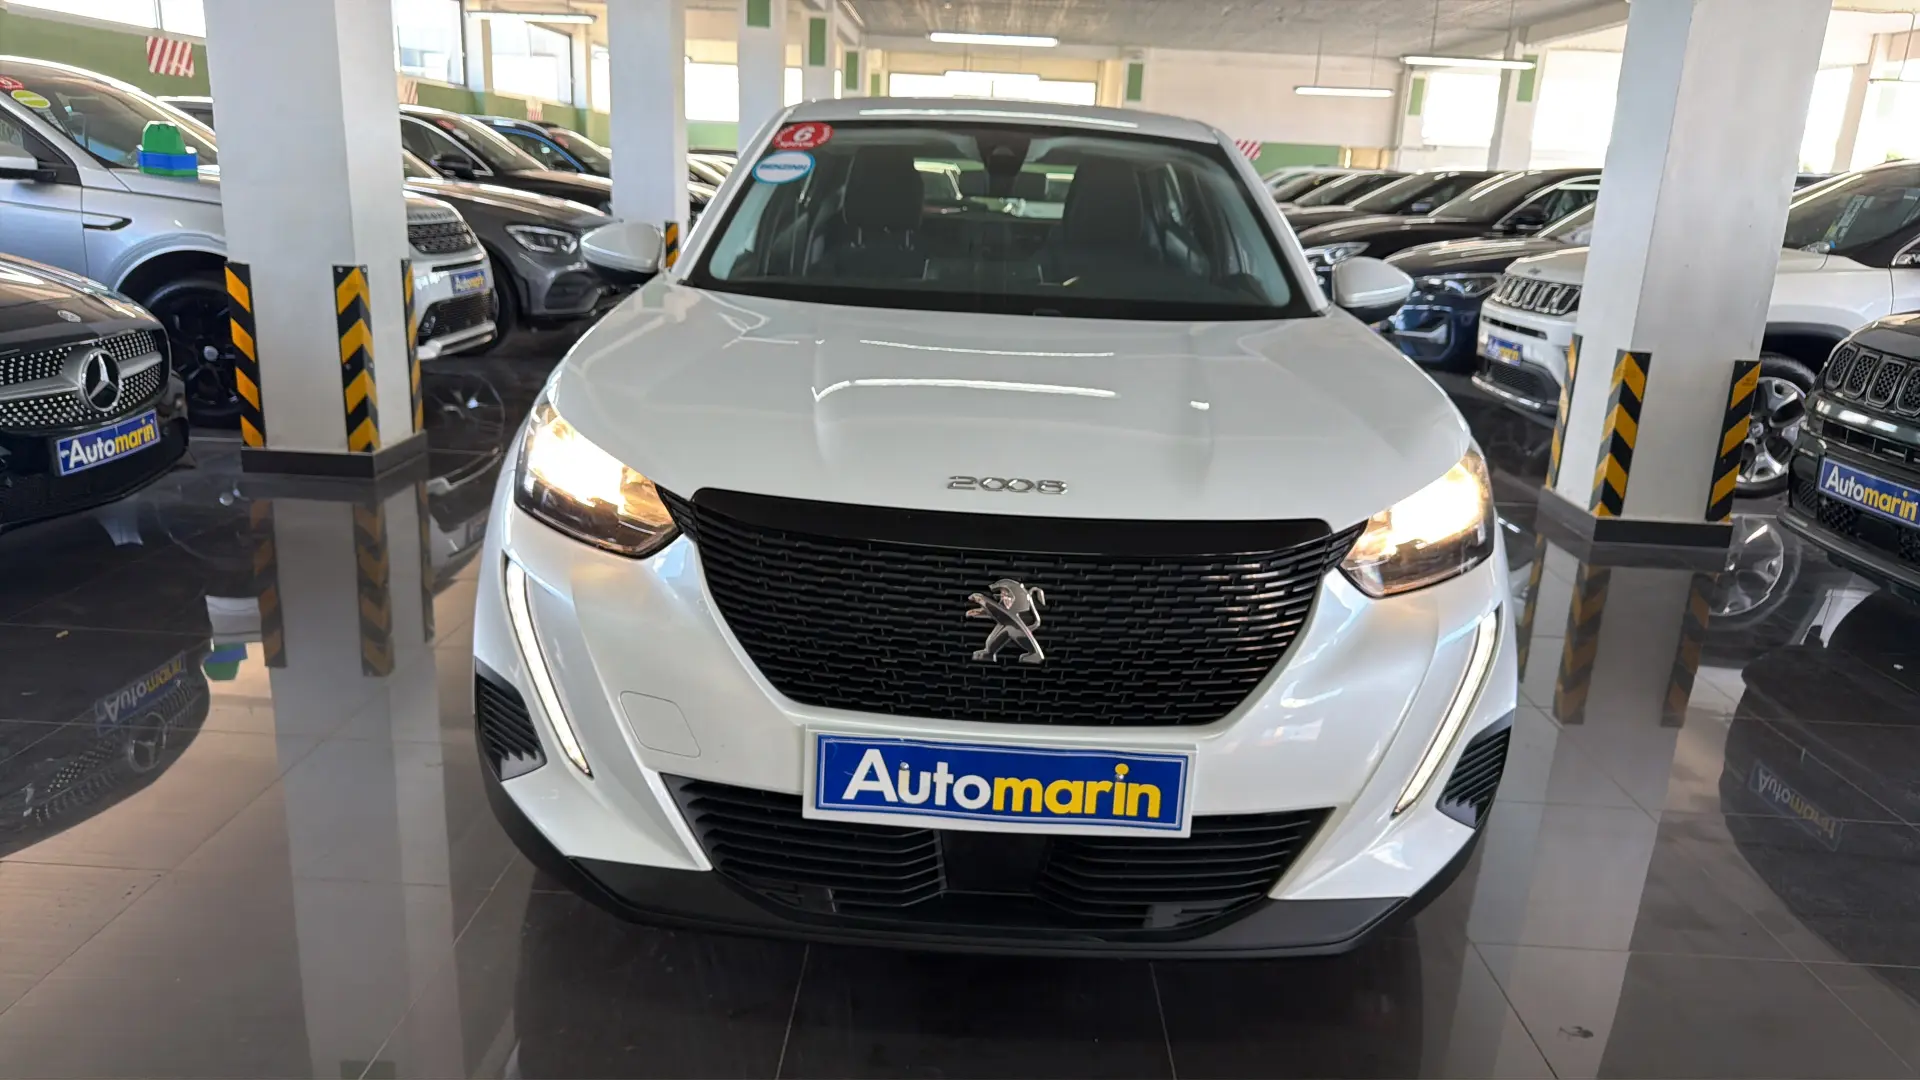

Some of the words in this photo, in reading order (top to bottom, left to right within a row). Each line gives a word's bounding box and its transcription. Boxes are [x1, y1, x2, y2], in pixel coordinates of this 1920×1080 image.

[793, 125, 816, 143] 6
[69, 417, 156, 469] Automarin
[946, 475, 1069, 495] 2008
[1825, 464, 1918, 522] Automarin
[841, 747, 1162, 819] Automarin
